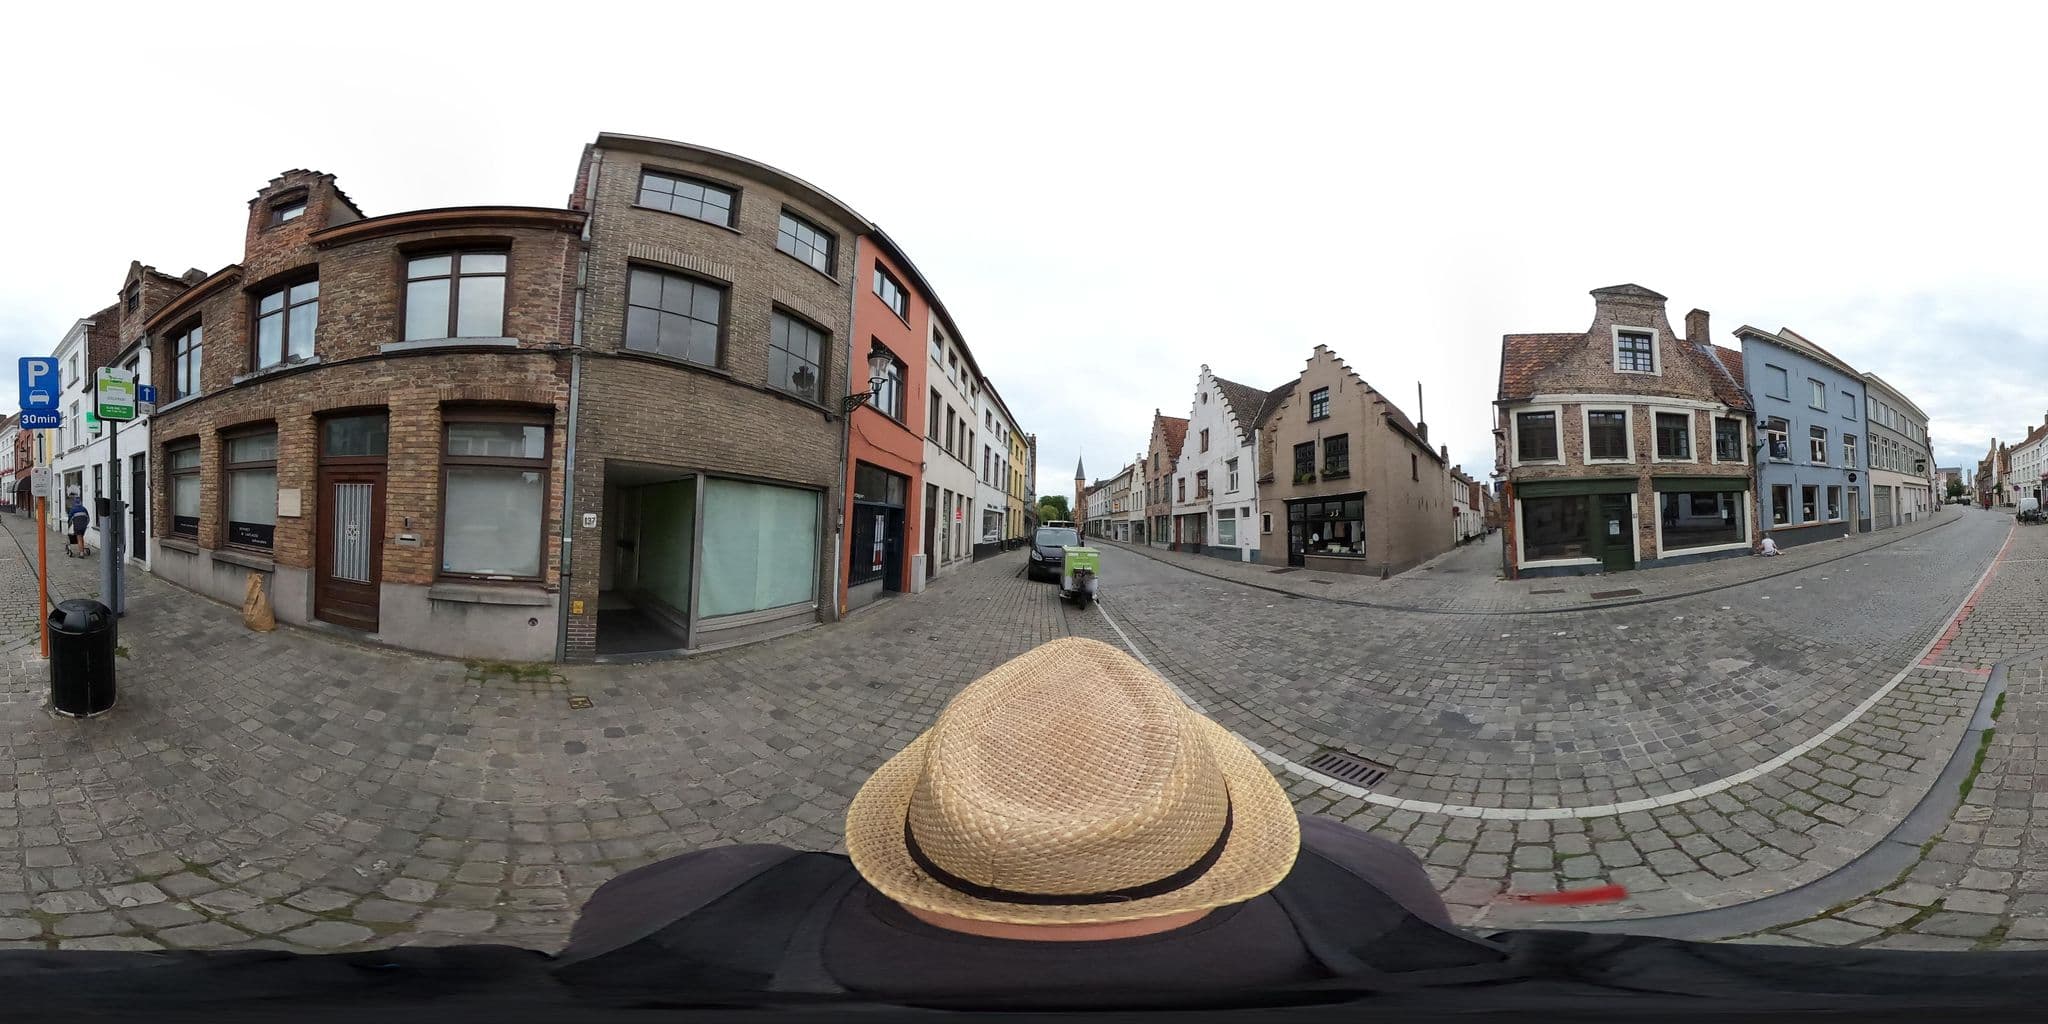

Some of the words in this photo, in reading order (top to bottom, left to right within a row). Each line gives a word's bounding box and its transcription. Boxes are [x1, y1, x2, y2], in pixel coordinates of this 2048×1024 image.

[28, 361, 49, 387] P
[22, 414, 57, 424] 30min
[585, 517, 596, 526] 137
